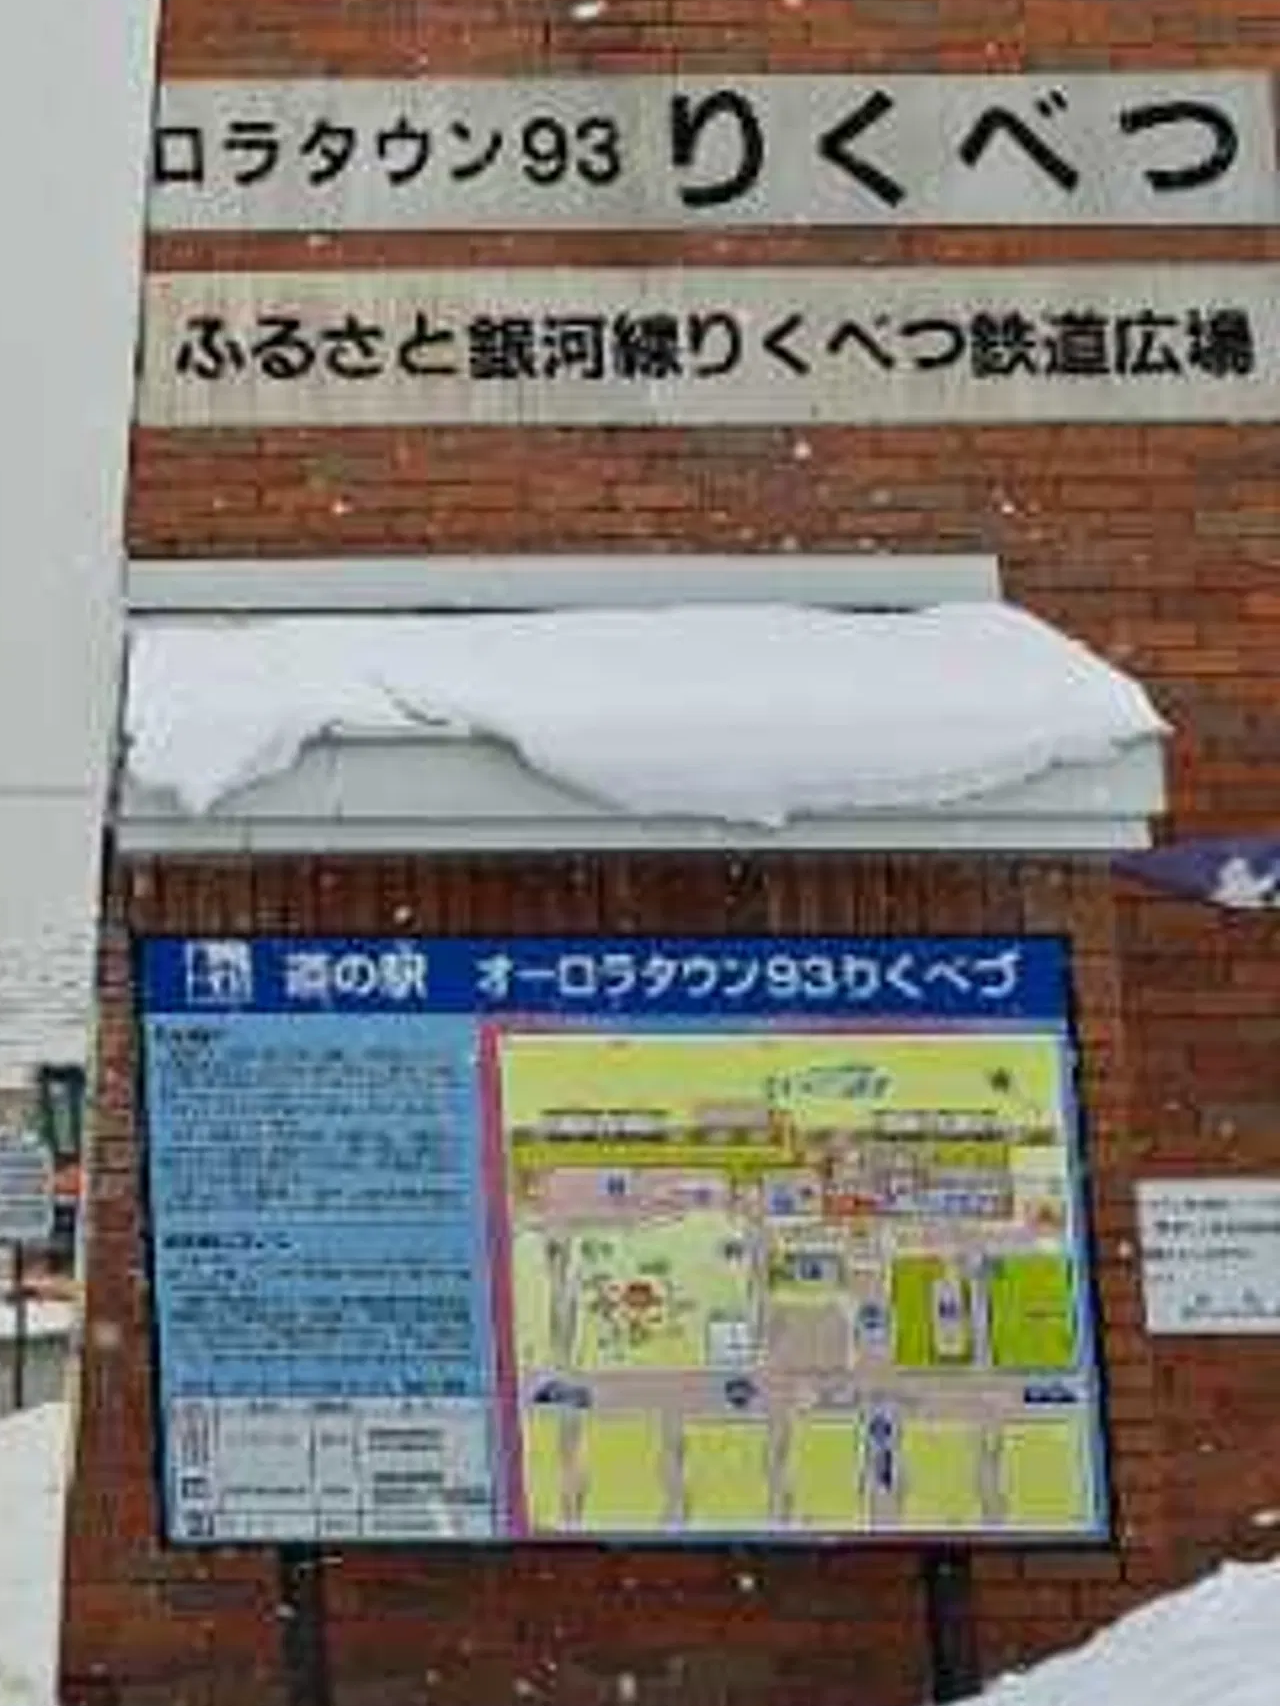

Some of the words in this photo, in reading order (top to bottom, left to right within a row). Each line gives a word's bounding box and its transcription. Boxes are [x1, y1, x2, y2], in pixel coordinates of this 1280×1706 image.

[155, 119, 622, 187] ロラタウン93
[670, 92, 1238, 206] りくべつ
[176, 311, 1255, 381] ふるさと銀河線りくべつ鉄道広場
